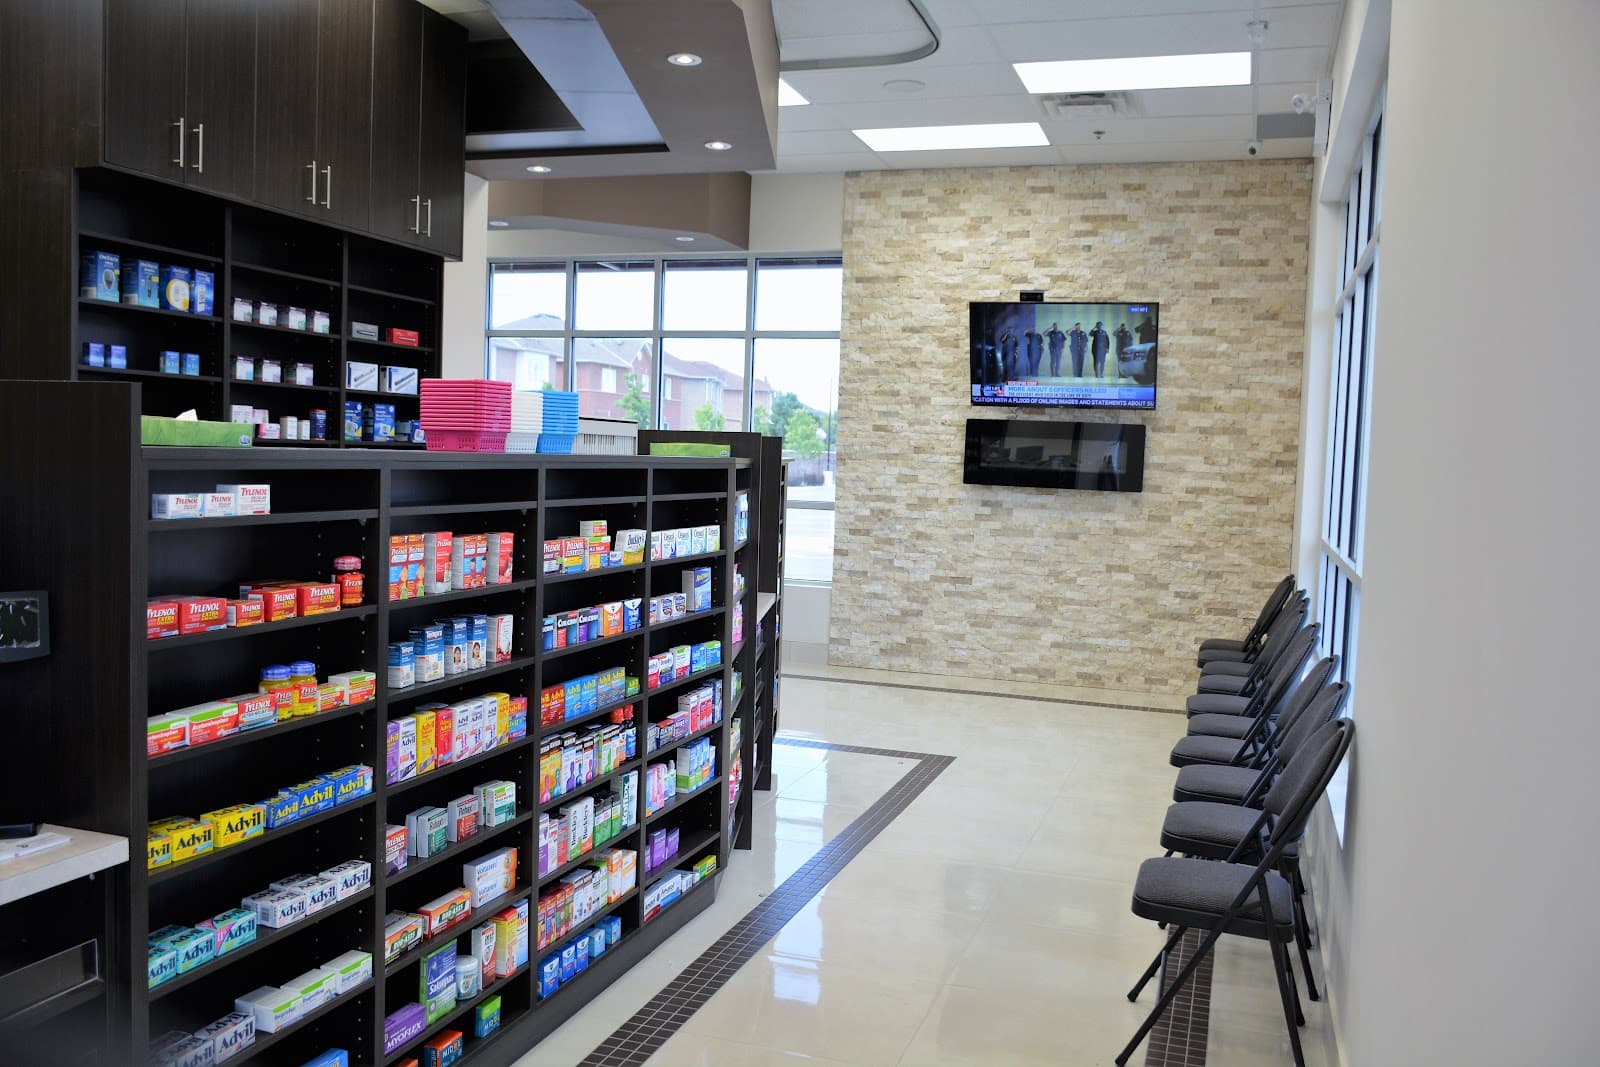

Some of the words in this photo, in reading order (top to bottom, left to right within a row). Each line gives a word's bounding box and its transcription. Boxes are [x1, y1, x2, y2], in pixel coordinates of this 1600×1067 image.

[175, 497, 198, 505] TYLENOL
[211, 495, 231, 503] TYLENOL
[241, 487, 267, 496] TYLENOL
[273, 592, 296, 603] TYLENOL
[310, 587, 335, 598] TYLENOL
[190, 602, 220, 614] TYLENOL
[201, 611, 219, 621] EXTRA
[241, 604, 261, 613] TYLENOL
[156, 615, 175, 626] EXTRA
[245, 700, 271, 712] TYLENOL
[338, 774, 364, 797] Advil
[300, 785, 334, 809] Advil
[275, 801, 299, 820] Advil
[224, 811, 262, 837] Advil
[176, 829, 212, 852] Advil
[147, 842, 171, 860] dvil
[341, 867, 369, 891] Advil
[310, 886, 337, 906] Advil
[280, 900, 305, 919] Advil
[226, 919, 255, 943] Advil
[183, 939, 213, 964] Advil
[148, 957, 176, 978] Advil
[219, 1021, 255, 1053] Advil
[386, 1021, 423, 1050] MYOFLEX
